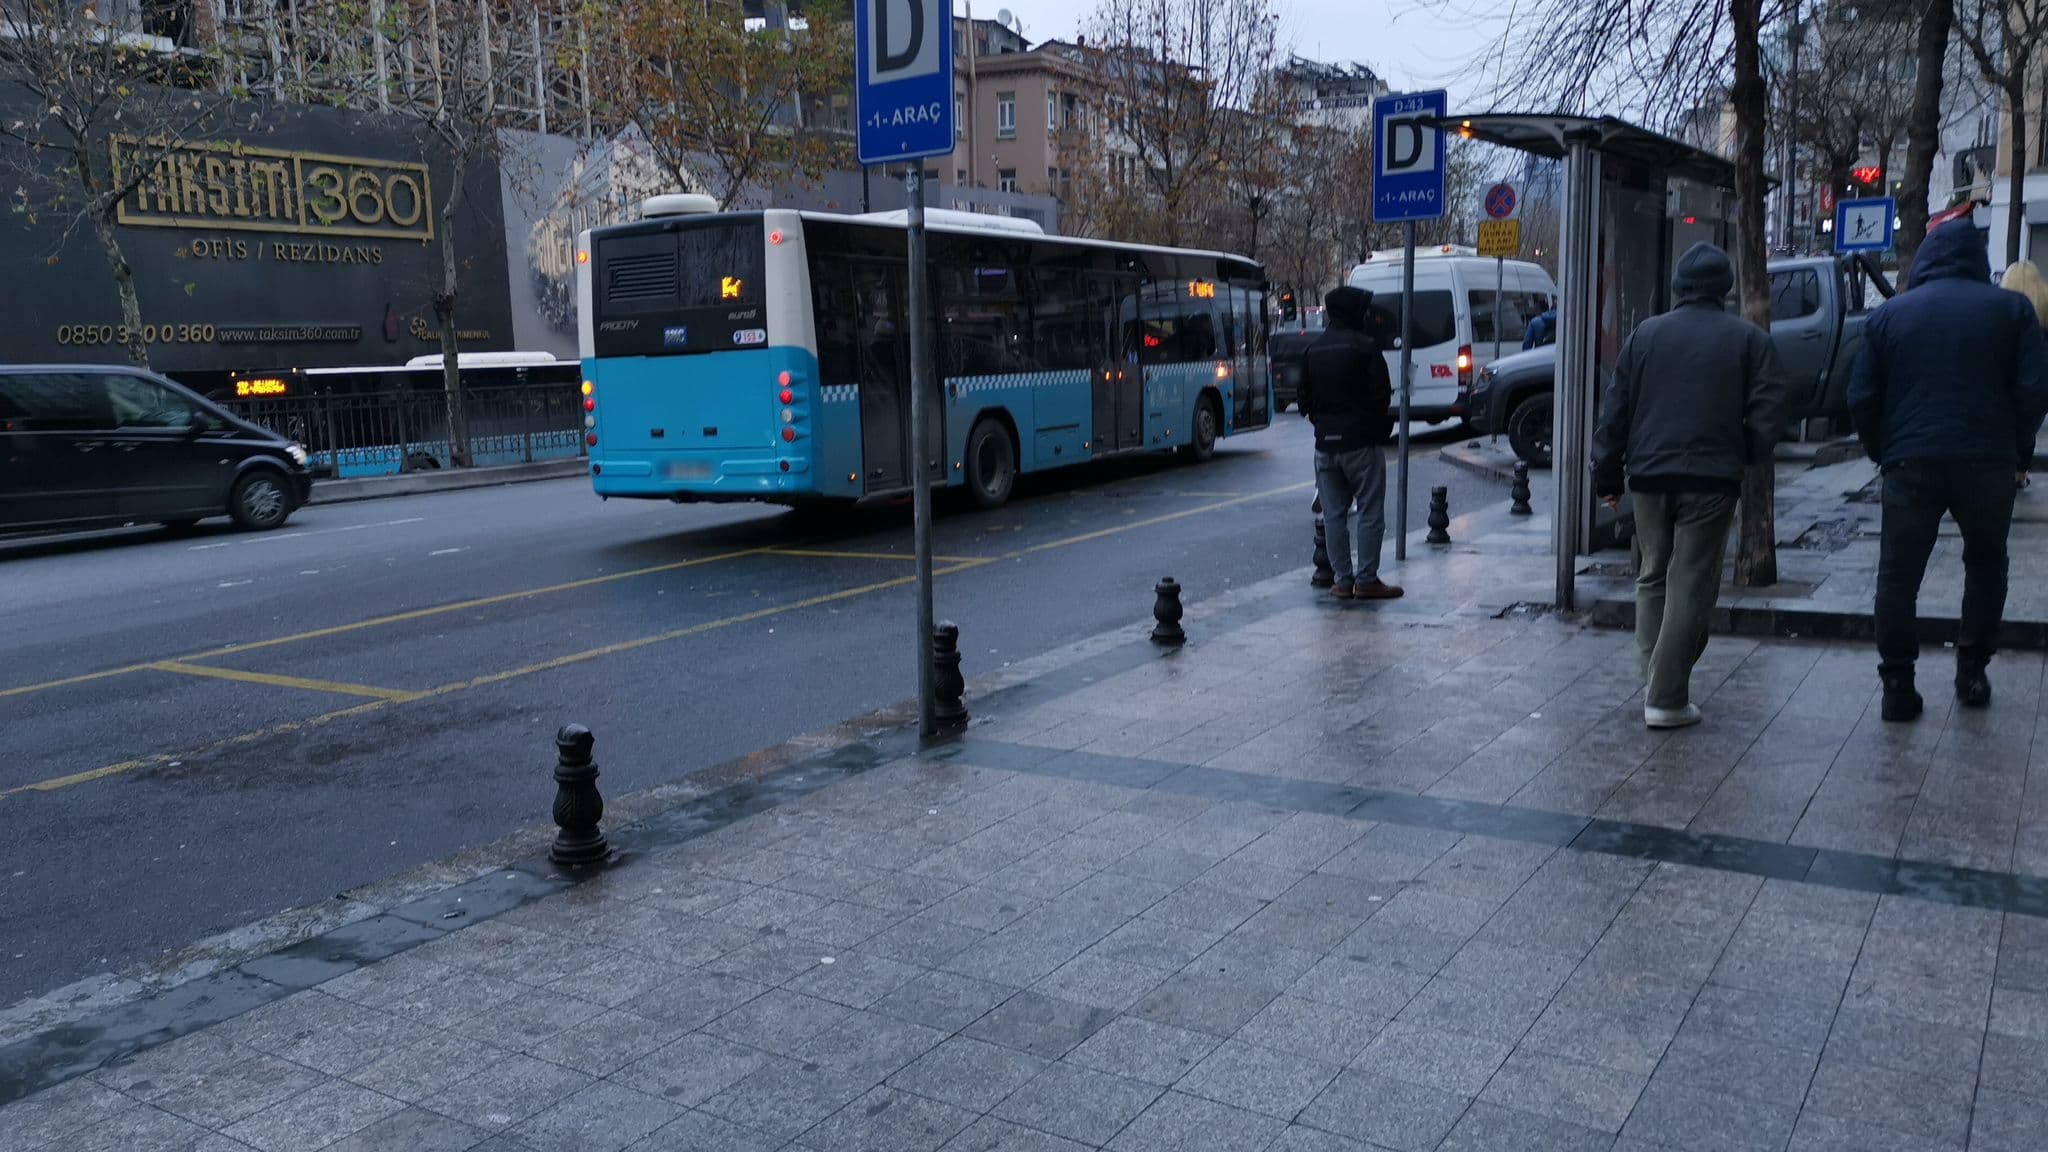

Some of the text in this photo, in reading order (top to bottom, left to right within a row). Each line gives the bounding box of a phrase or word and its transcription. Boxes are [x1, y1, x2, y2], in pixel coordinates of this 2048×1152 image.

[875, 0, 924, 73] D
[892, 102, 941, 126] ARAÇ
[1395, 97, 1424, 113] D-43
[1386, 117, 1423, 170] D
[310, 166, 421, 226] 360
[1399, 188, 1435, 203] ARAÇ
[191, 237, 247, 260] OFİS
[272, 239, 383, 264] REZİDANS
[57, 325, 112, 344] 0850
[117, 325, 156, 344] 30
[178, 324, 215, 342] 360
